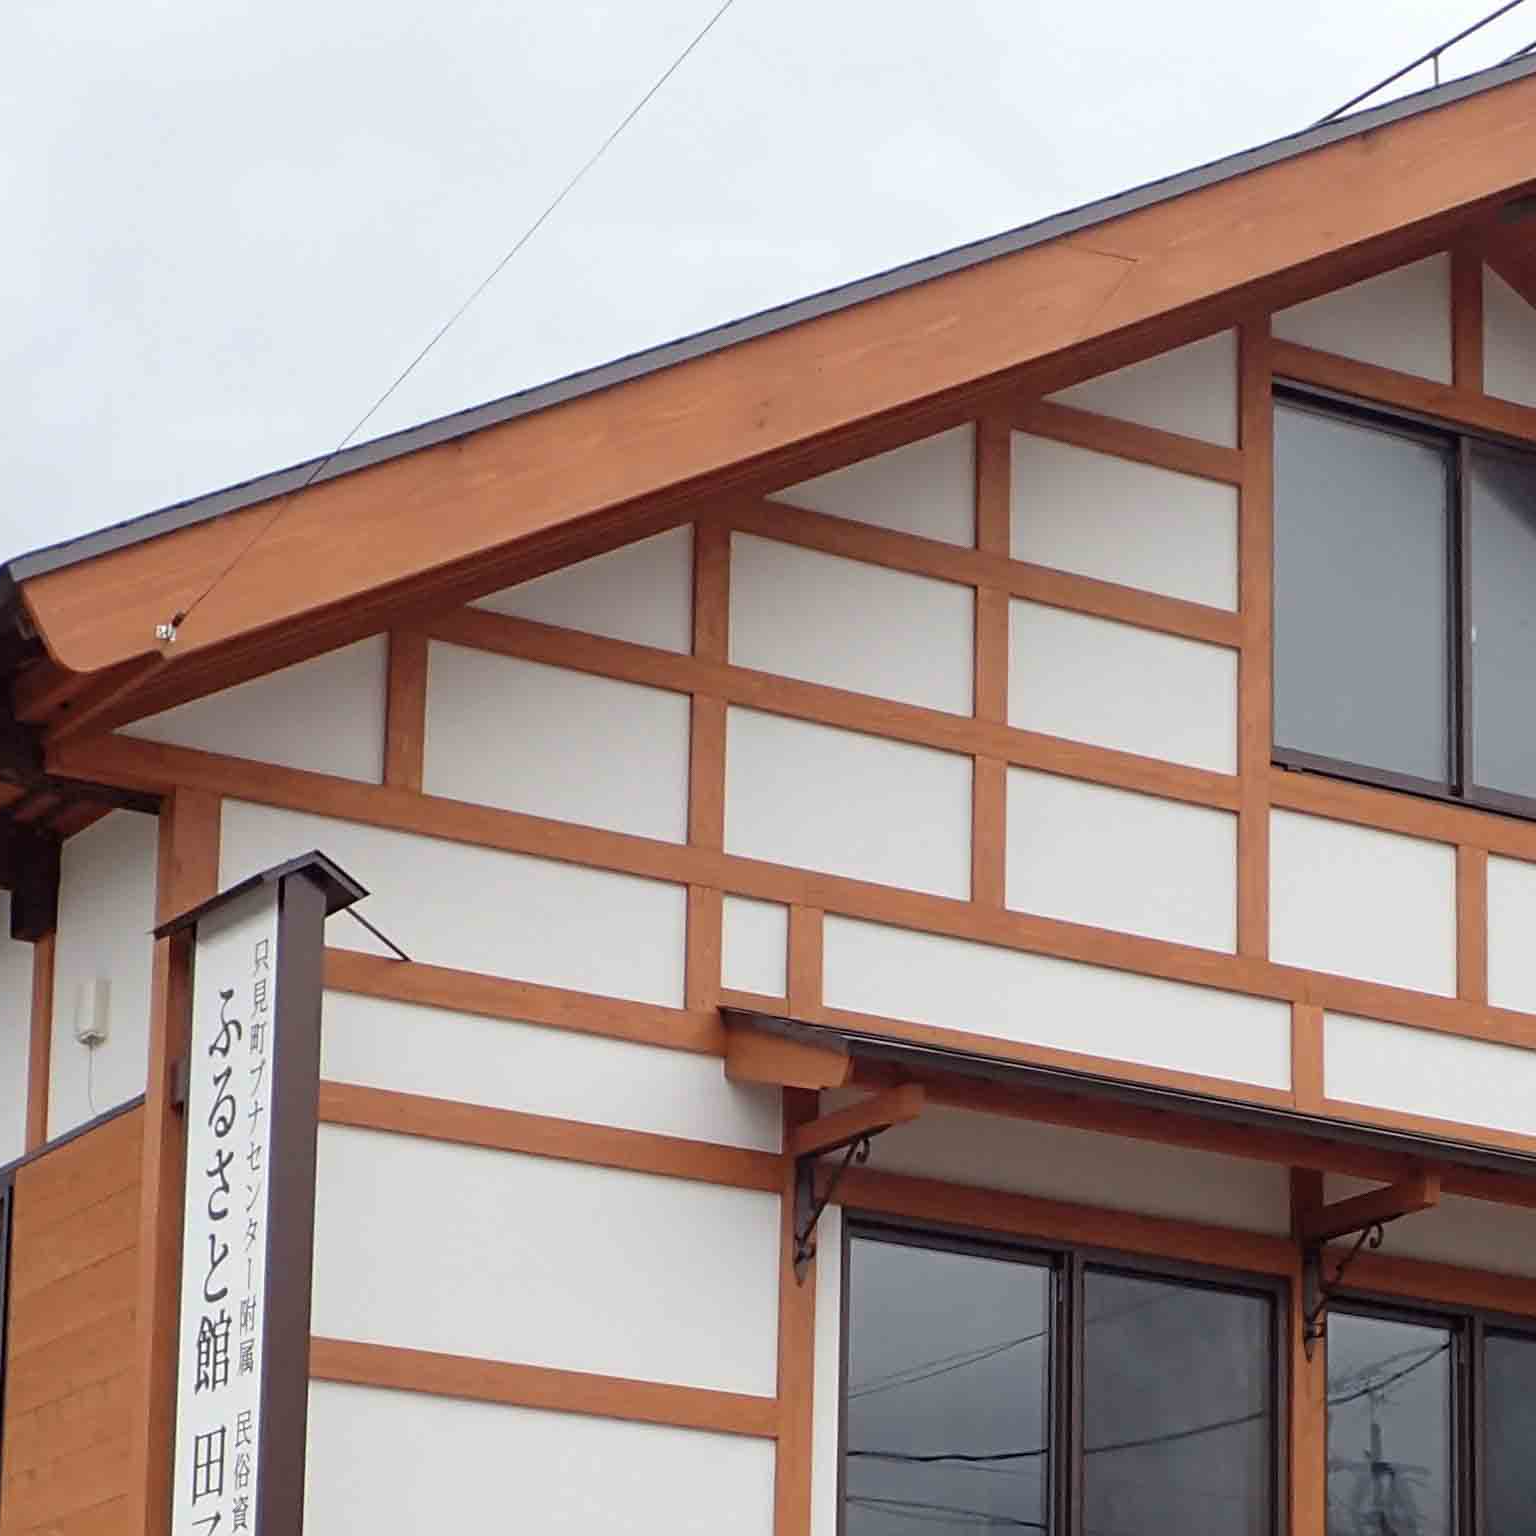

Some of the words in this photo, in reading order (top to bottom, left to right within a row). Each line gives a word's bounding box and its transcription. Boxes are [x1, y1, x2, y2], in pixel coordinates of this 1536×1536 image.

[194, 988, 242, 1396] ふるさと館
[238, 939, 270, 1376] 只見町ブナセンター附属
